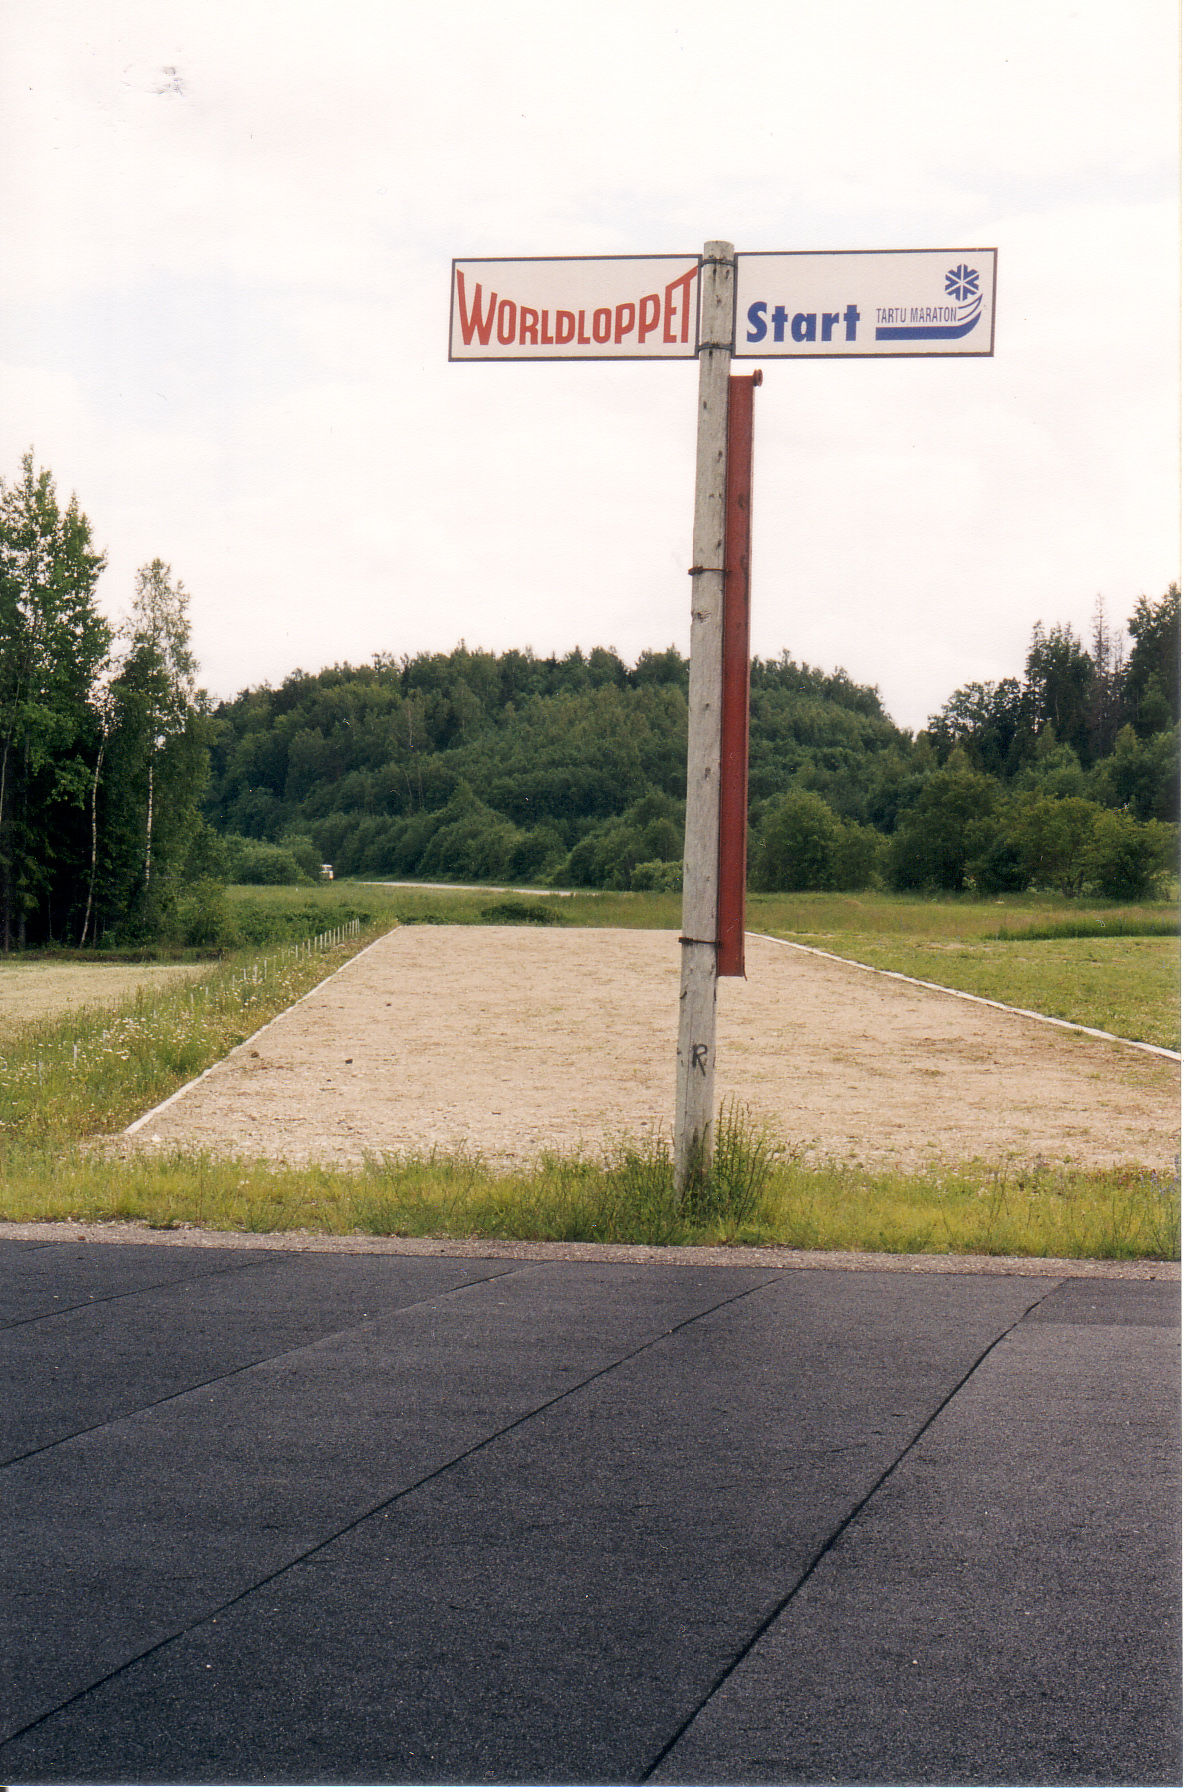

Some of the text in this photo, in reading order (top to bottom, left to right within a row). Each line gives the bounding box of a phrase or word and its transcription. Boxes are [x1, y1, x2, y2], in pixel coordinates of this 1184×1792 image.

[456, 265, 699, 346] WORLDLOPPET
[746, 301, 861, 343] Start
[876, 306, 957, 323] TARTU MARATON
